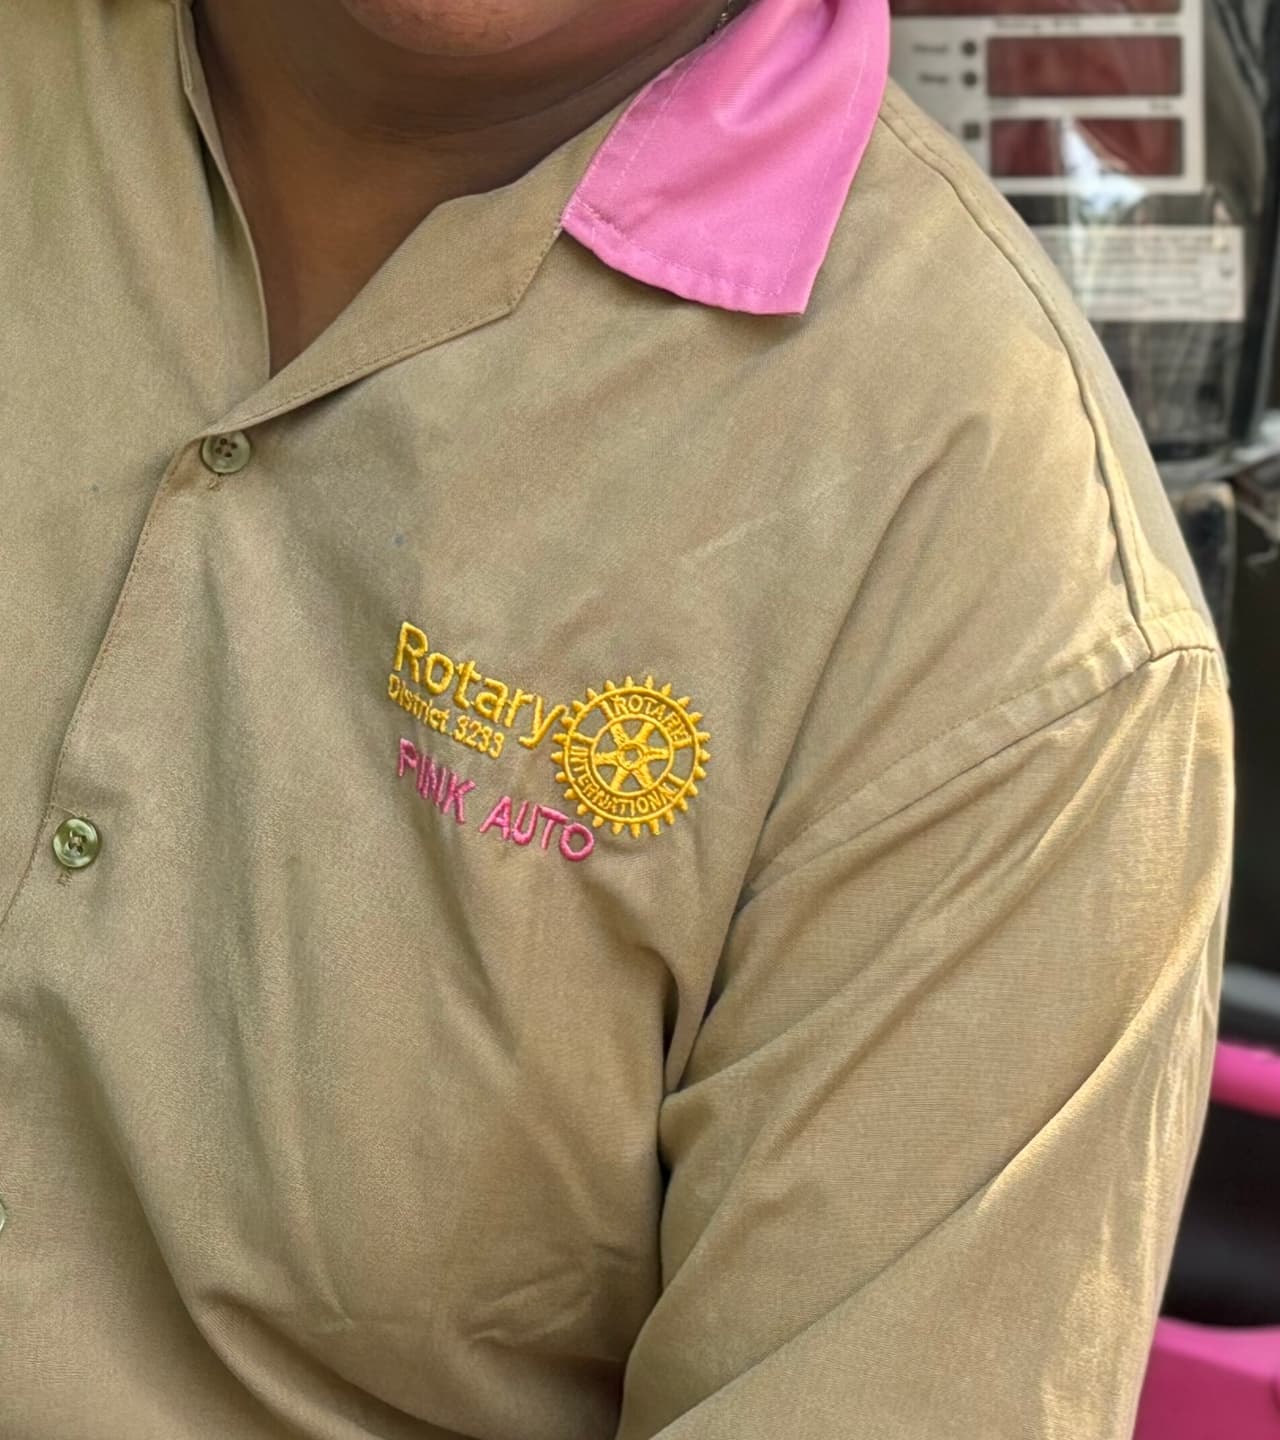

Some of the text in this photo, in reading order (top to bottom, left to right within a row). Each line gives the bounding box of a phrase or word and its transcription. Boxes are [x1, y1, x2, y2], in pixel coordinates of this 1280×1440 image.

[388, 673, 450, 734] District
[393, 621, 568, 749] Rotary
[397, 737, 595, 861] PINK AUTO
